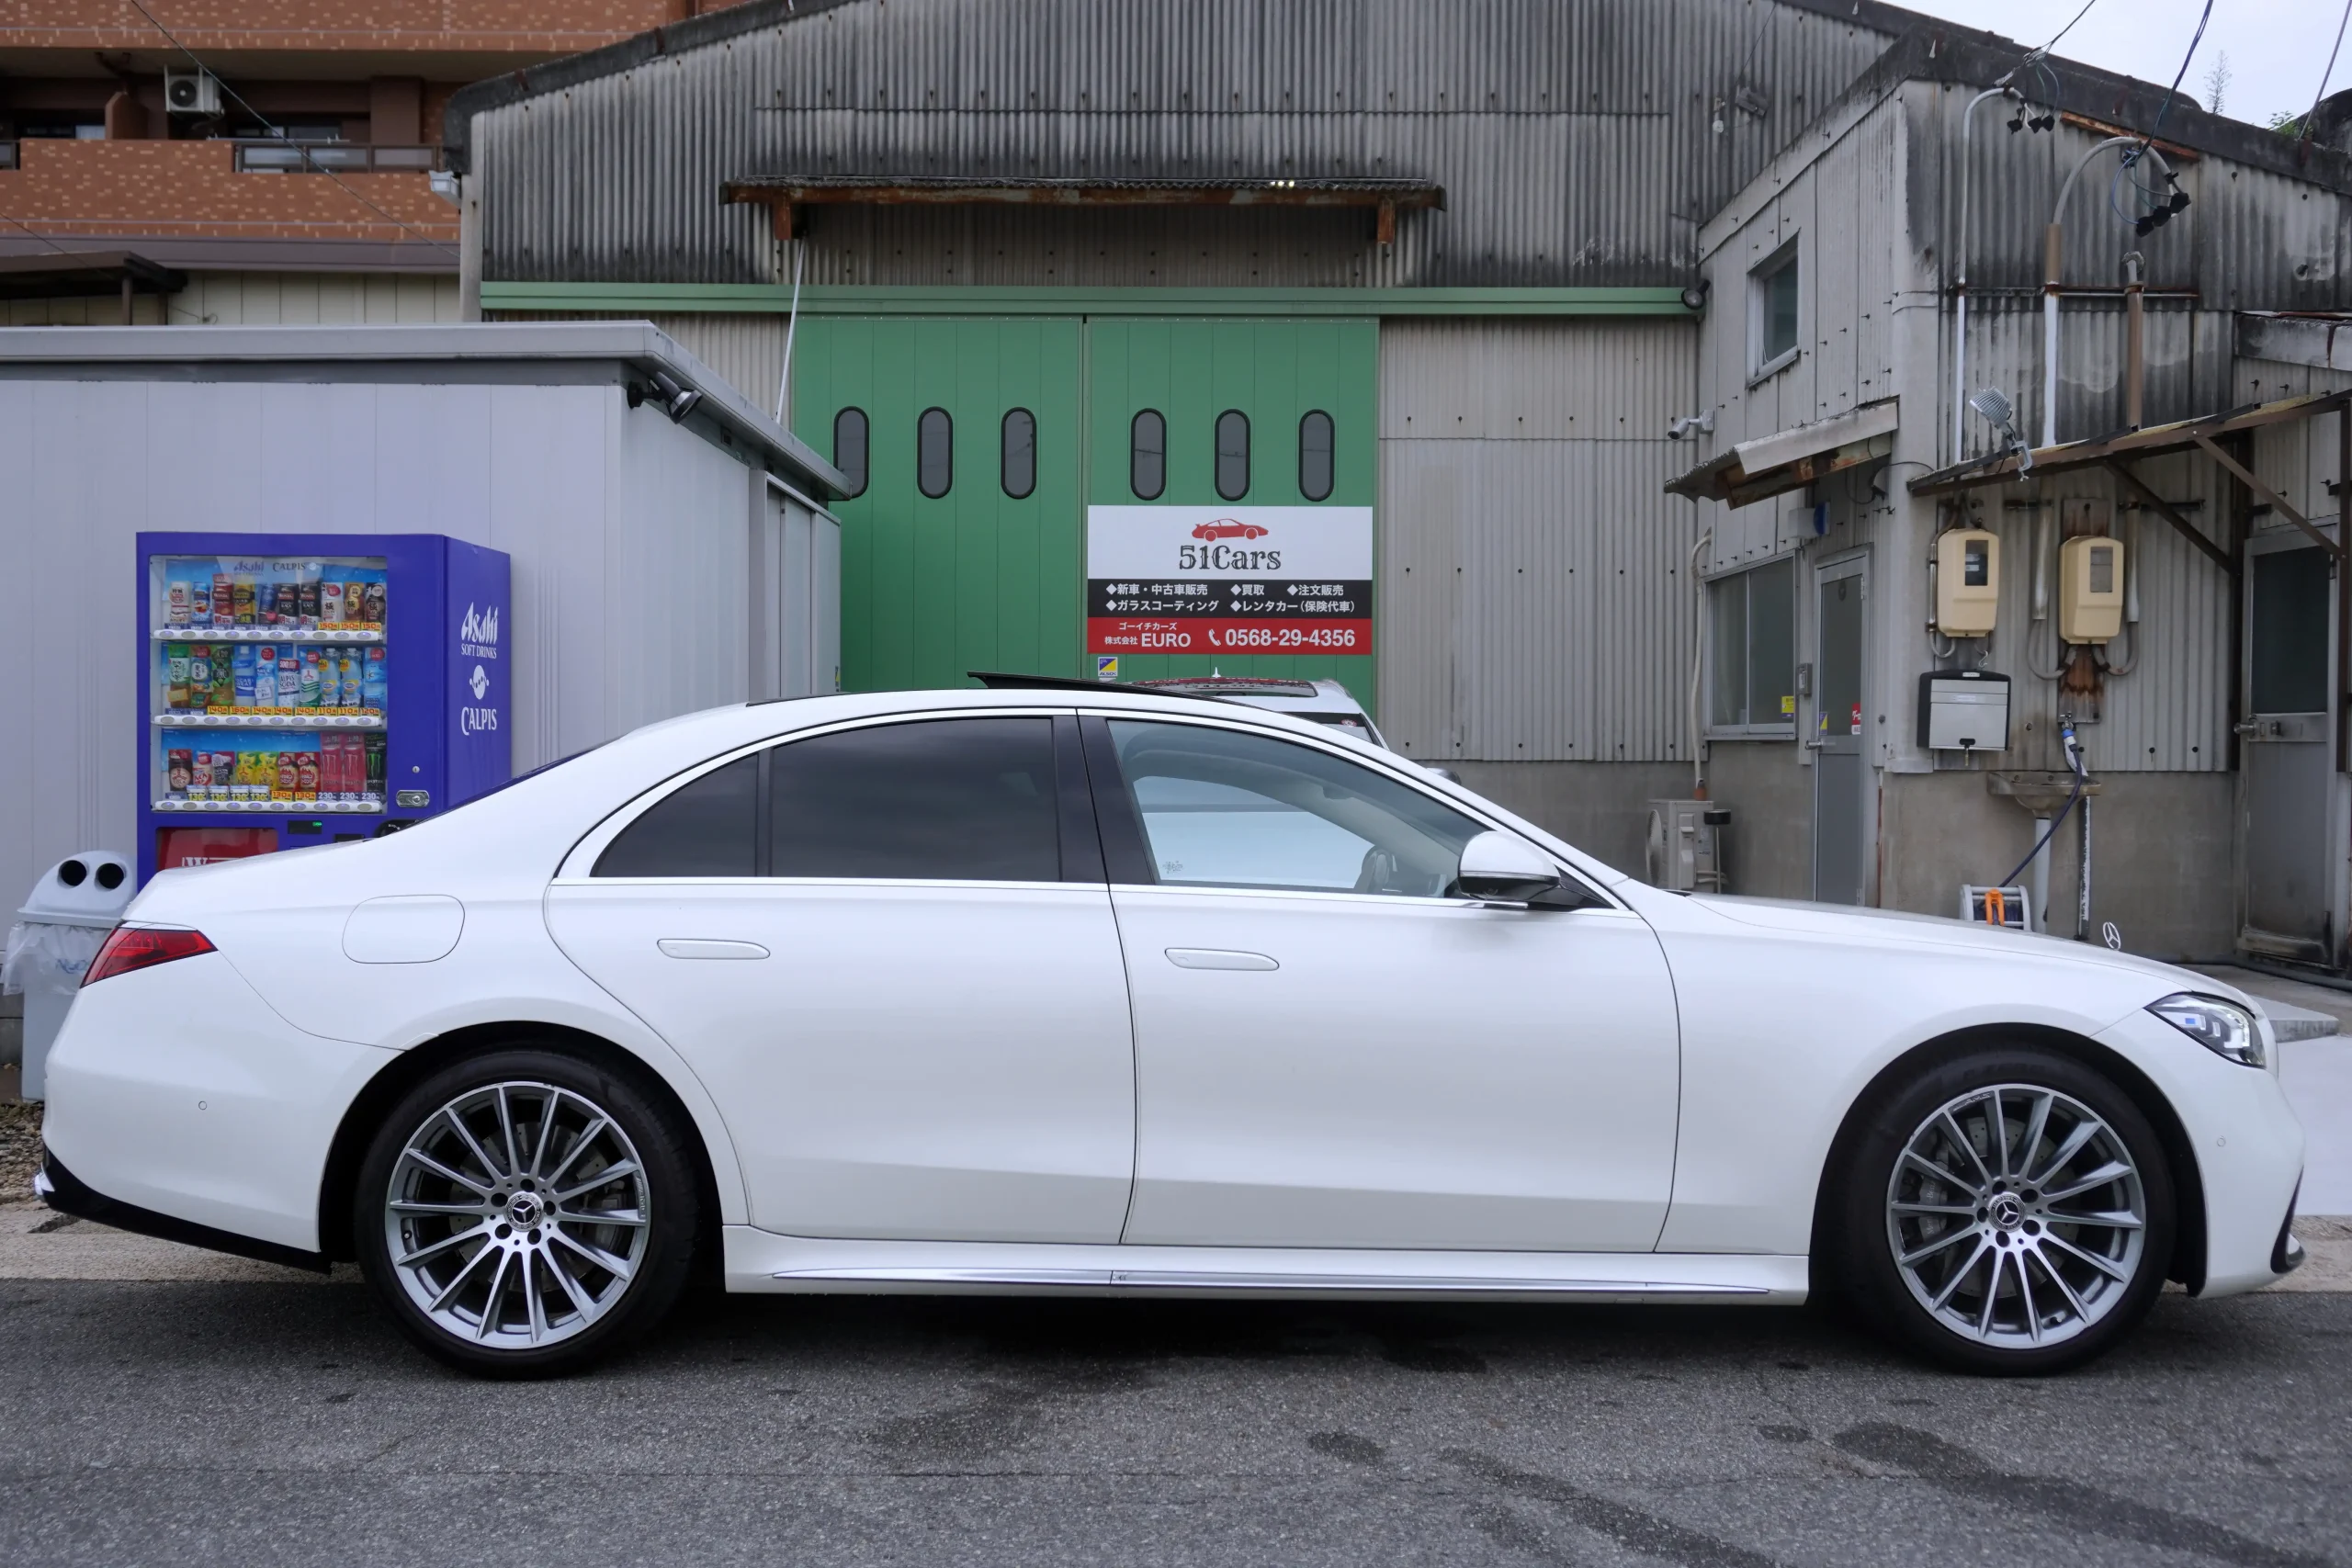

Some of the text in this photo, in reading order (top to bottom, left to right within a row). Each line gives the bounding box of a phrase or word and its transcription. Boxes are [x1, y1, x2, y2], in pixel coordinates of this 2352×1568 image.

[1180, 546, 1281, 570] 51Cars
[233, 560, 265, 572] Asahi
[273, 562, 305, 572] CALPIS
[1117, 584, 1207, 595] 新車・中古車販売
[1242, 584, 1264, 595] 買取
[1299, 584, 1343, 595] 注文販売
[1117, 601, 1218, 612] ガラスコーティング
[461, 601, 498, 645] Asahi
[1119, 622, 1177, 630] ゴーイチカーズ
[1104, 634, 1191, 647] 株式会社 EURO
[1226, 629, 1355, 647] 0568-29-4356
[461, 643, 496, 659] SOFT DRINKS
[461, 707, 497, 735] CALPIS
